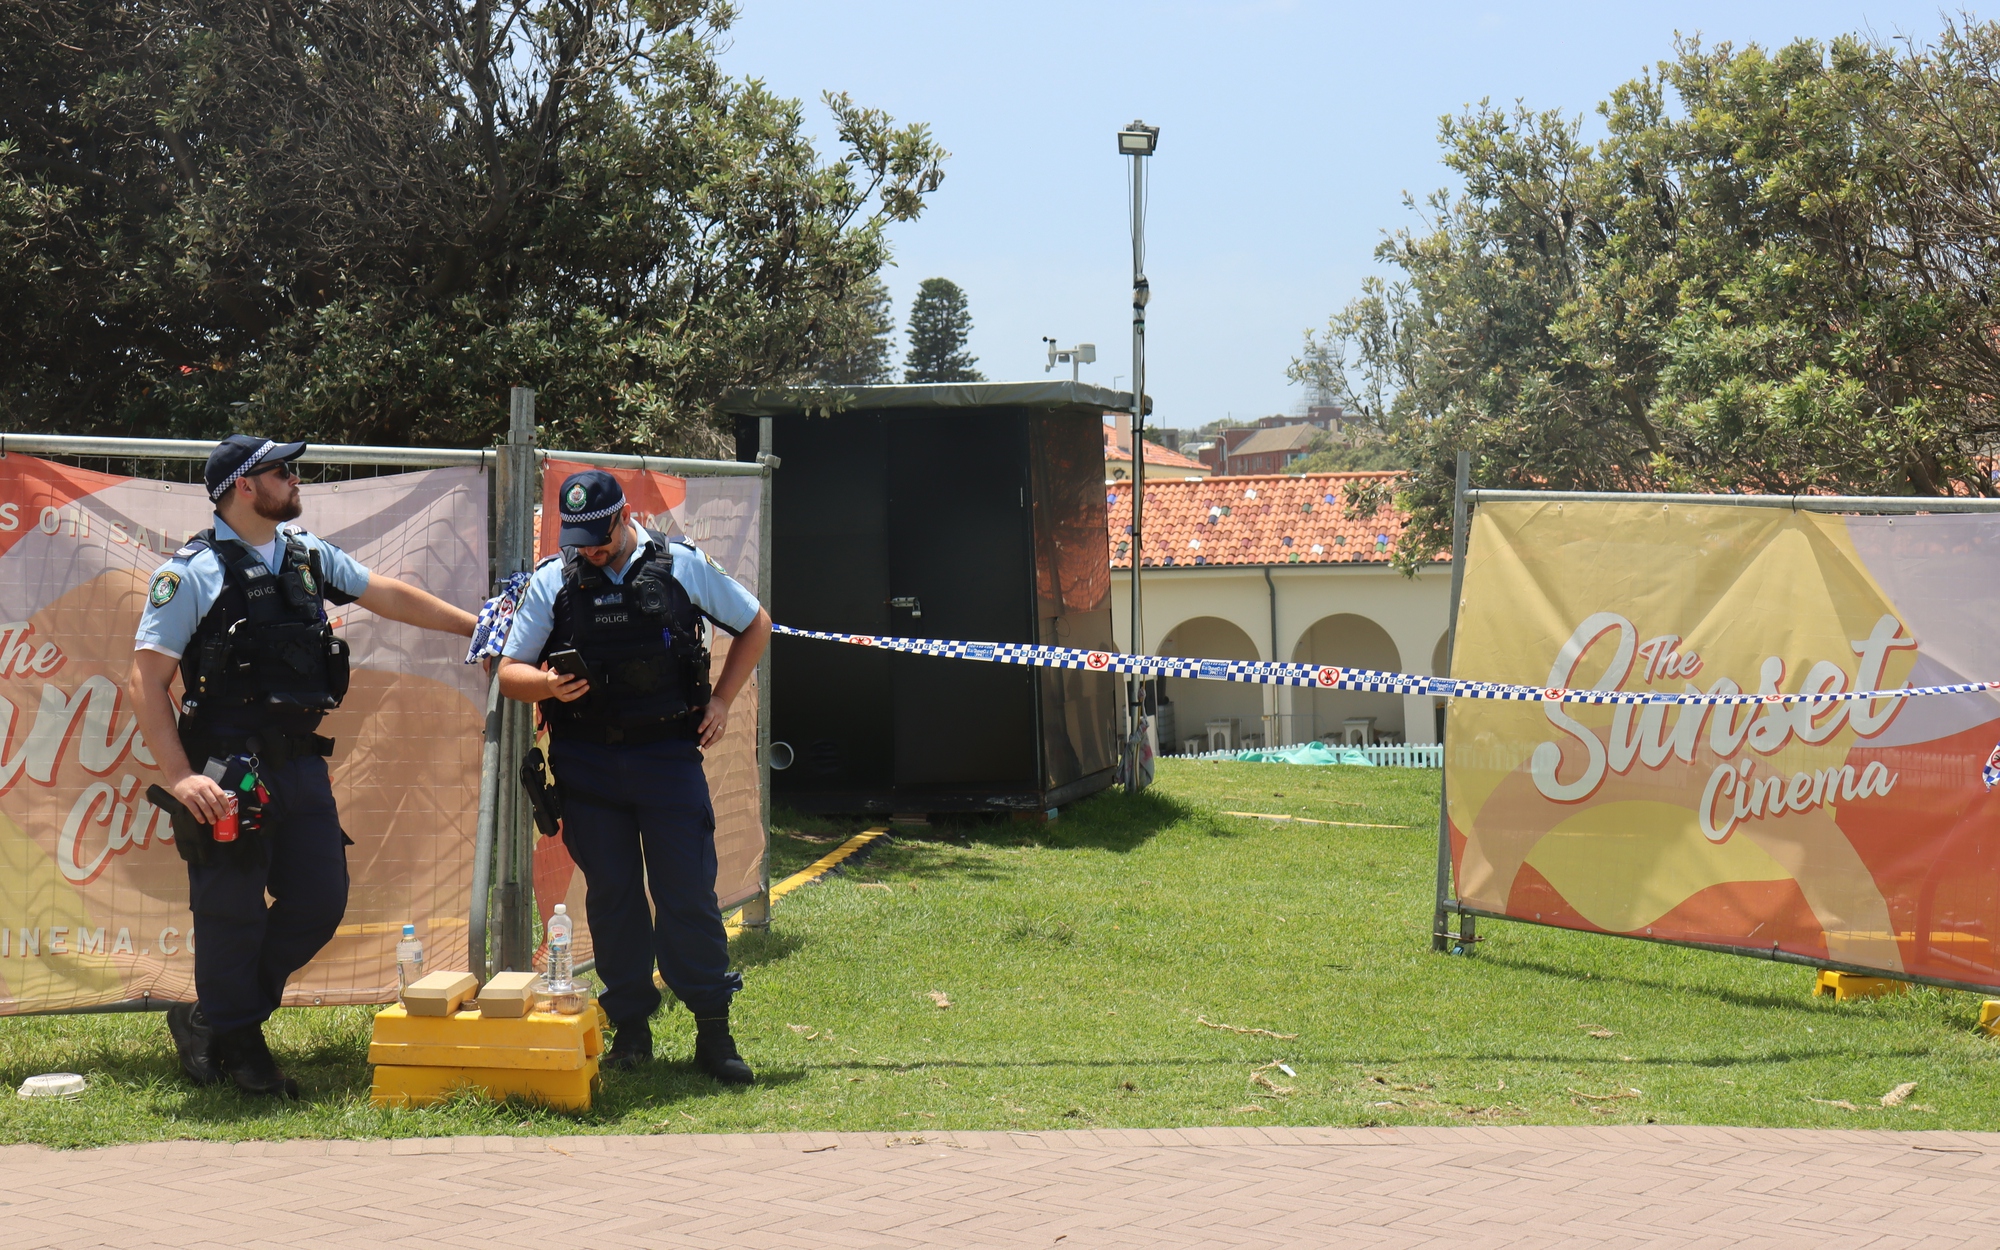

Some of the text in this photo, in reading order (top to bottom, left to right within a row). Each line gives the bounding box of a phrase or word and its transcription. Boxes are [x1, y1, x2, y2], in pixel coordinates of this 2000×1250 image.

[39, 506, 90, 538] ON
[247, 586, 276, 599] POLICE
[595, 614, 629, 624] POLICE
[1638, 635, 1704, 684] The
[1531, 612, 1918, 805] Sunset
[1699, 758, 1899, 844] Cinema
[57, 774, 175, 885] Cin
